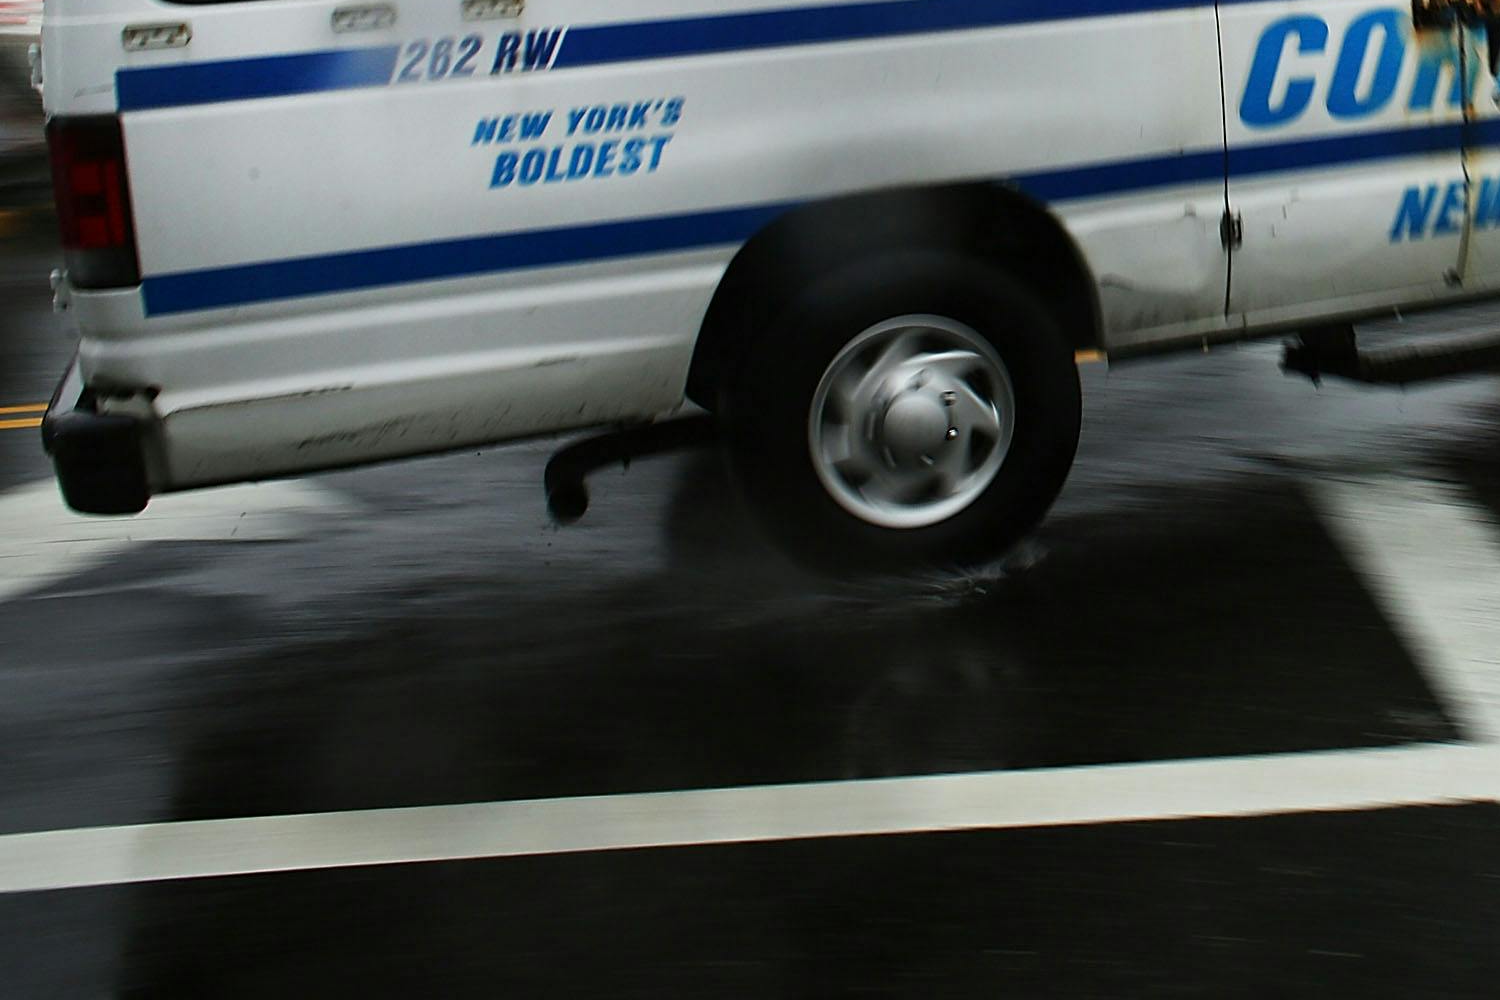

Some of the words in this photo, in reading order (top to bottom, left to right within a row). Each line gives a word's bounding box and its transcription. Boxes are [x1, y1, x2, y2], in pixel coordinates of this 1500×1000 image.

[399, 35, 483, 81] 262
[491, 28, 563, 74] RW
[471, 112, 553, 146] NEW
[566, 97, 685, 136] YORK'S
[489, 136, 672, 189] BOLDEST
